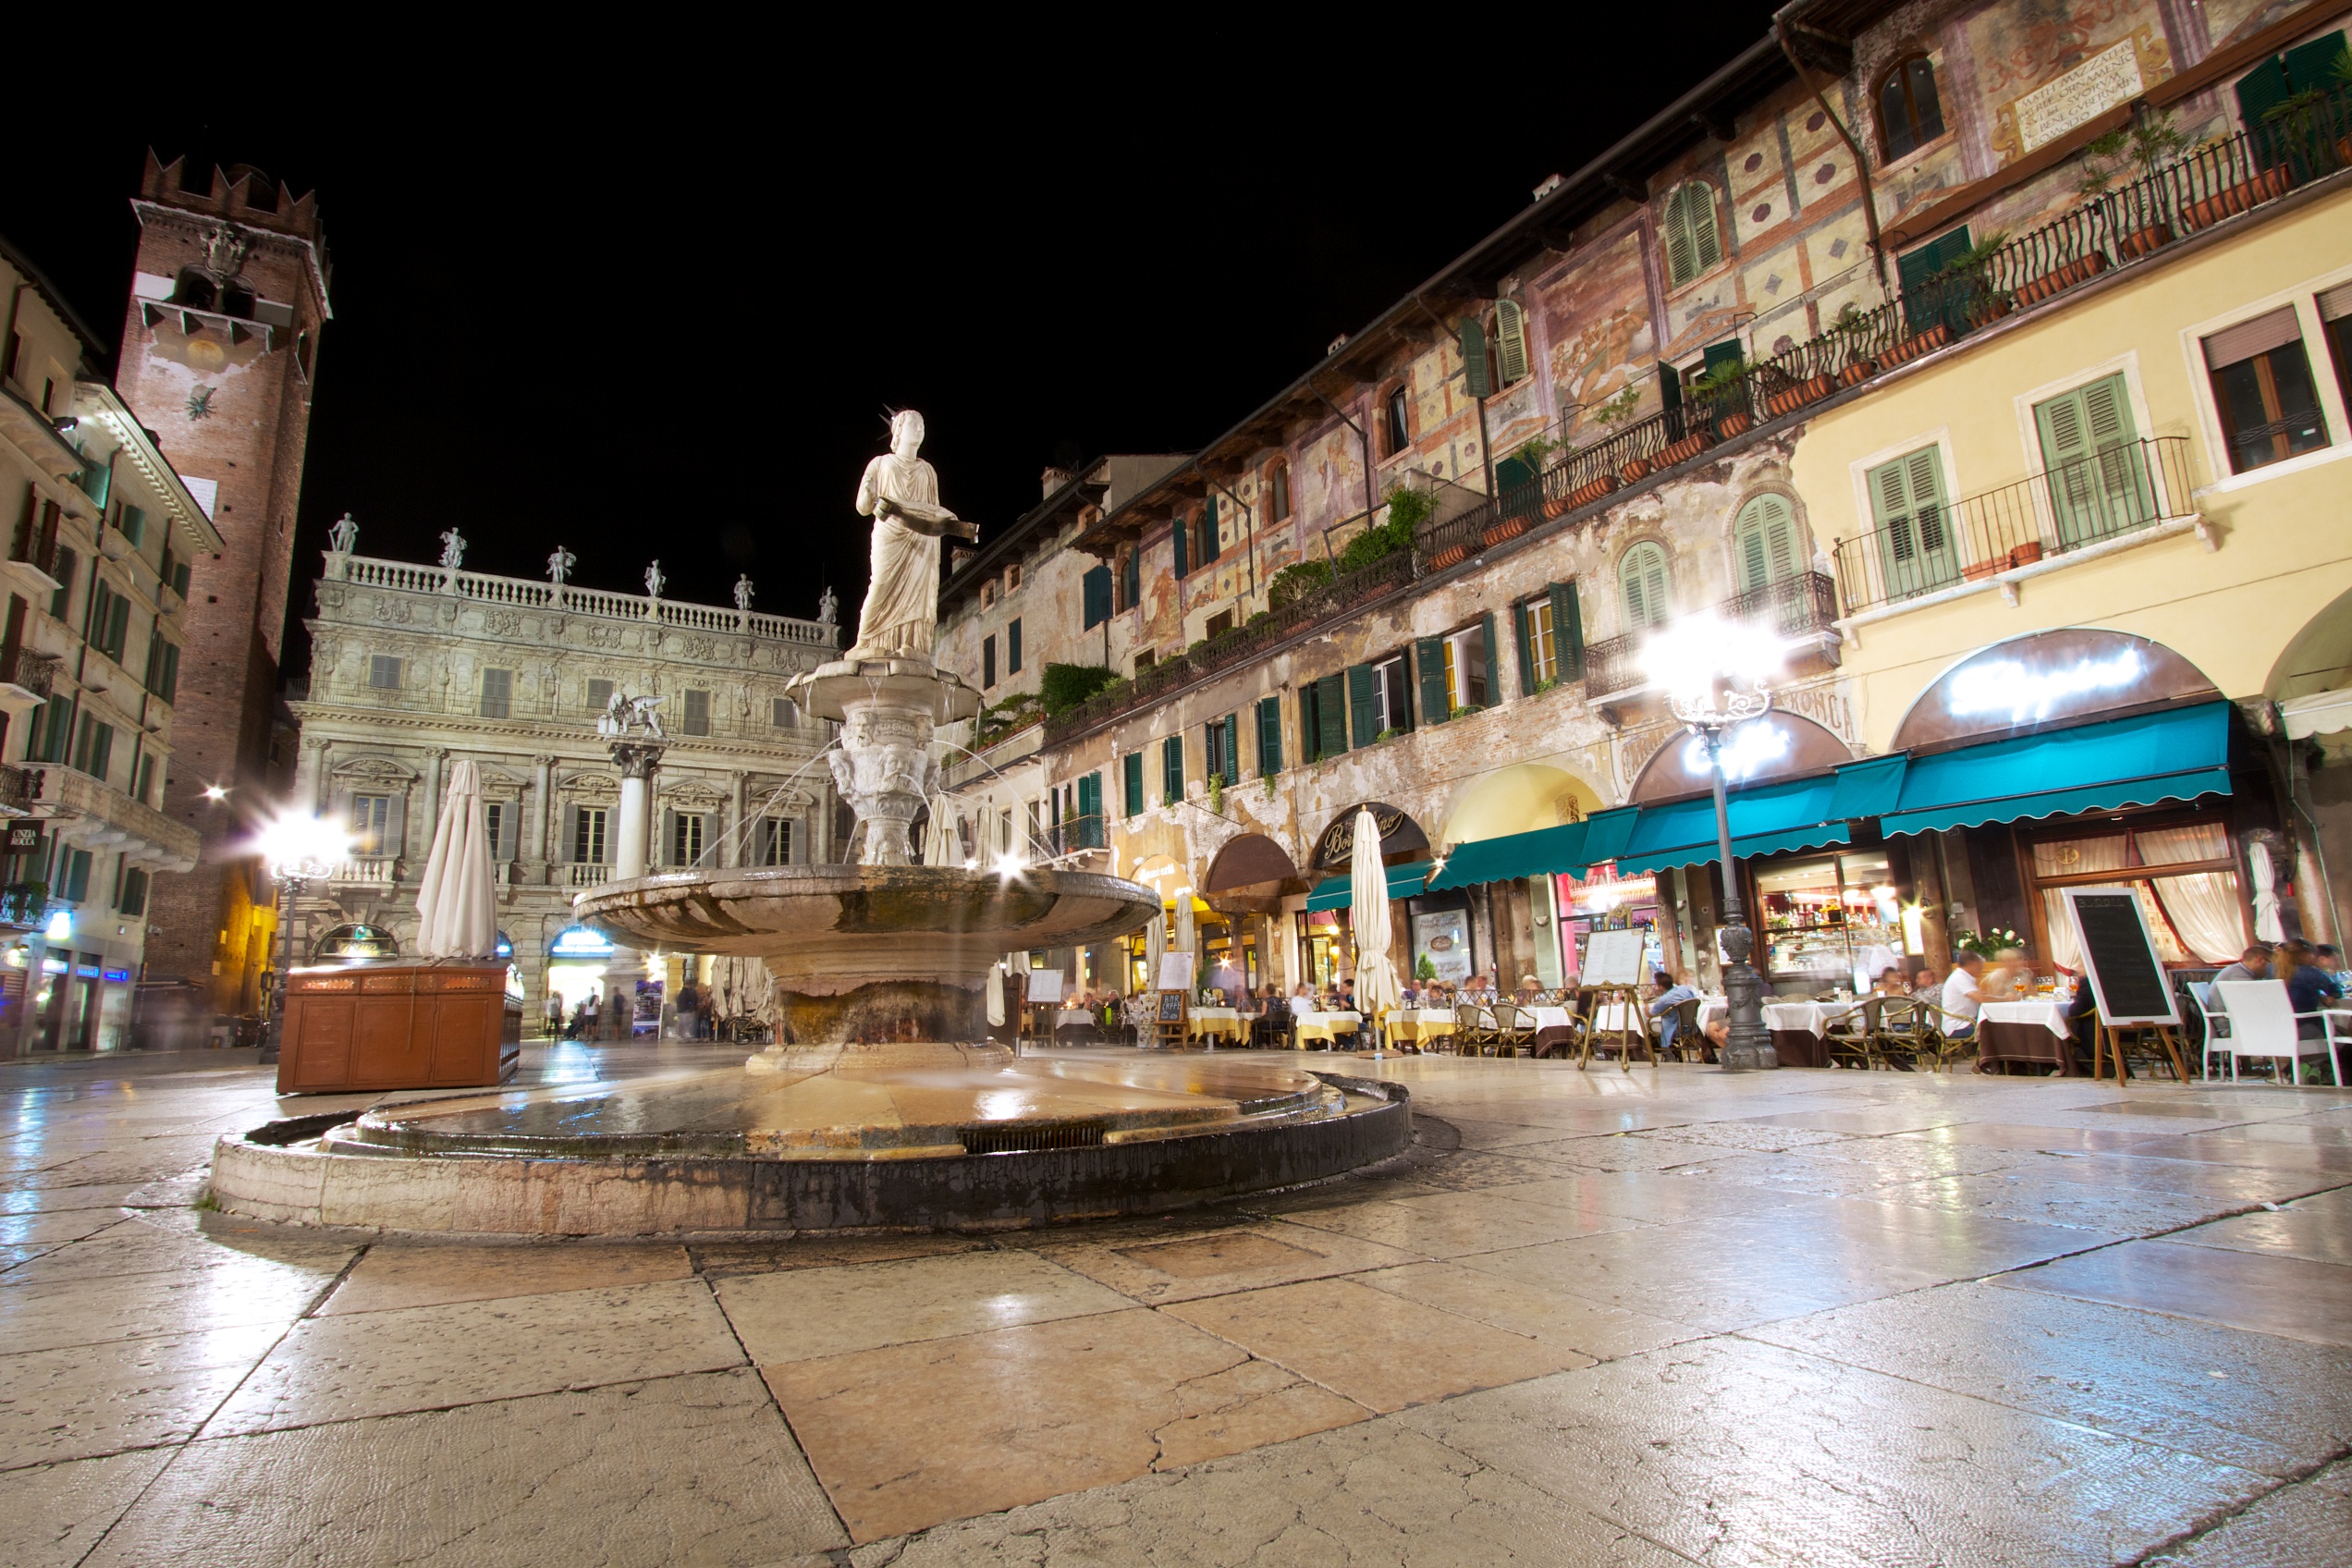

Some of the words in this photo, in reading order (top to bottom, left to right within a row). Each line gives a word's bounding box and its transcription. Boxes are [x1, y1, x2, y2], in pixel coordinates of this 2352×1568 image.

[2021, 83, 2055, 108] MATH
[2065, 70, 2121, 106] SVORVM
[2029, 110, 2089, 148] COMODO
[2040, 111, 2066, 131] BENE
